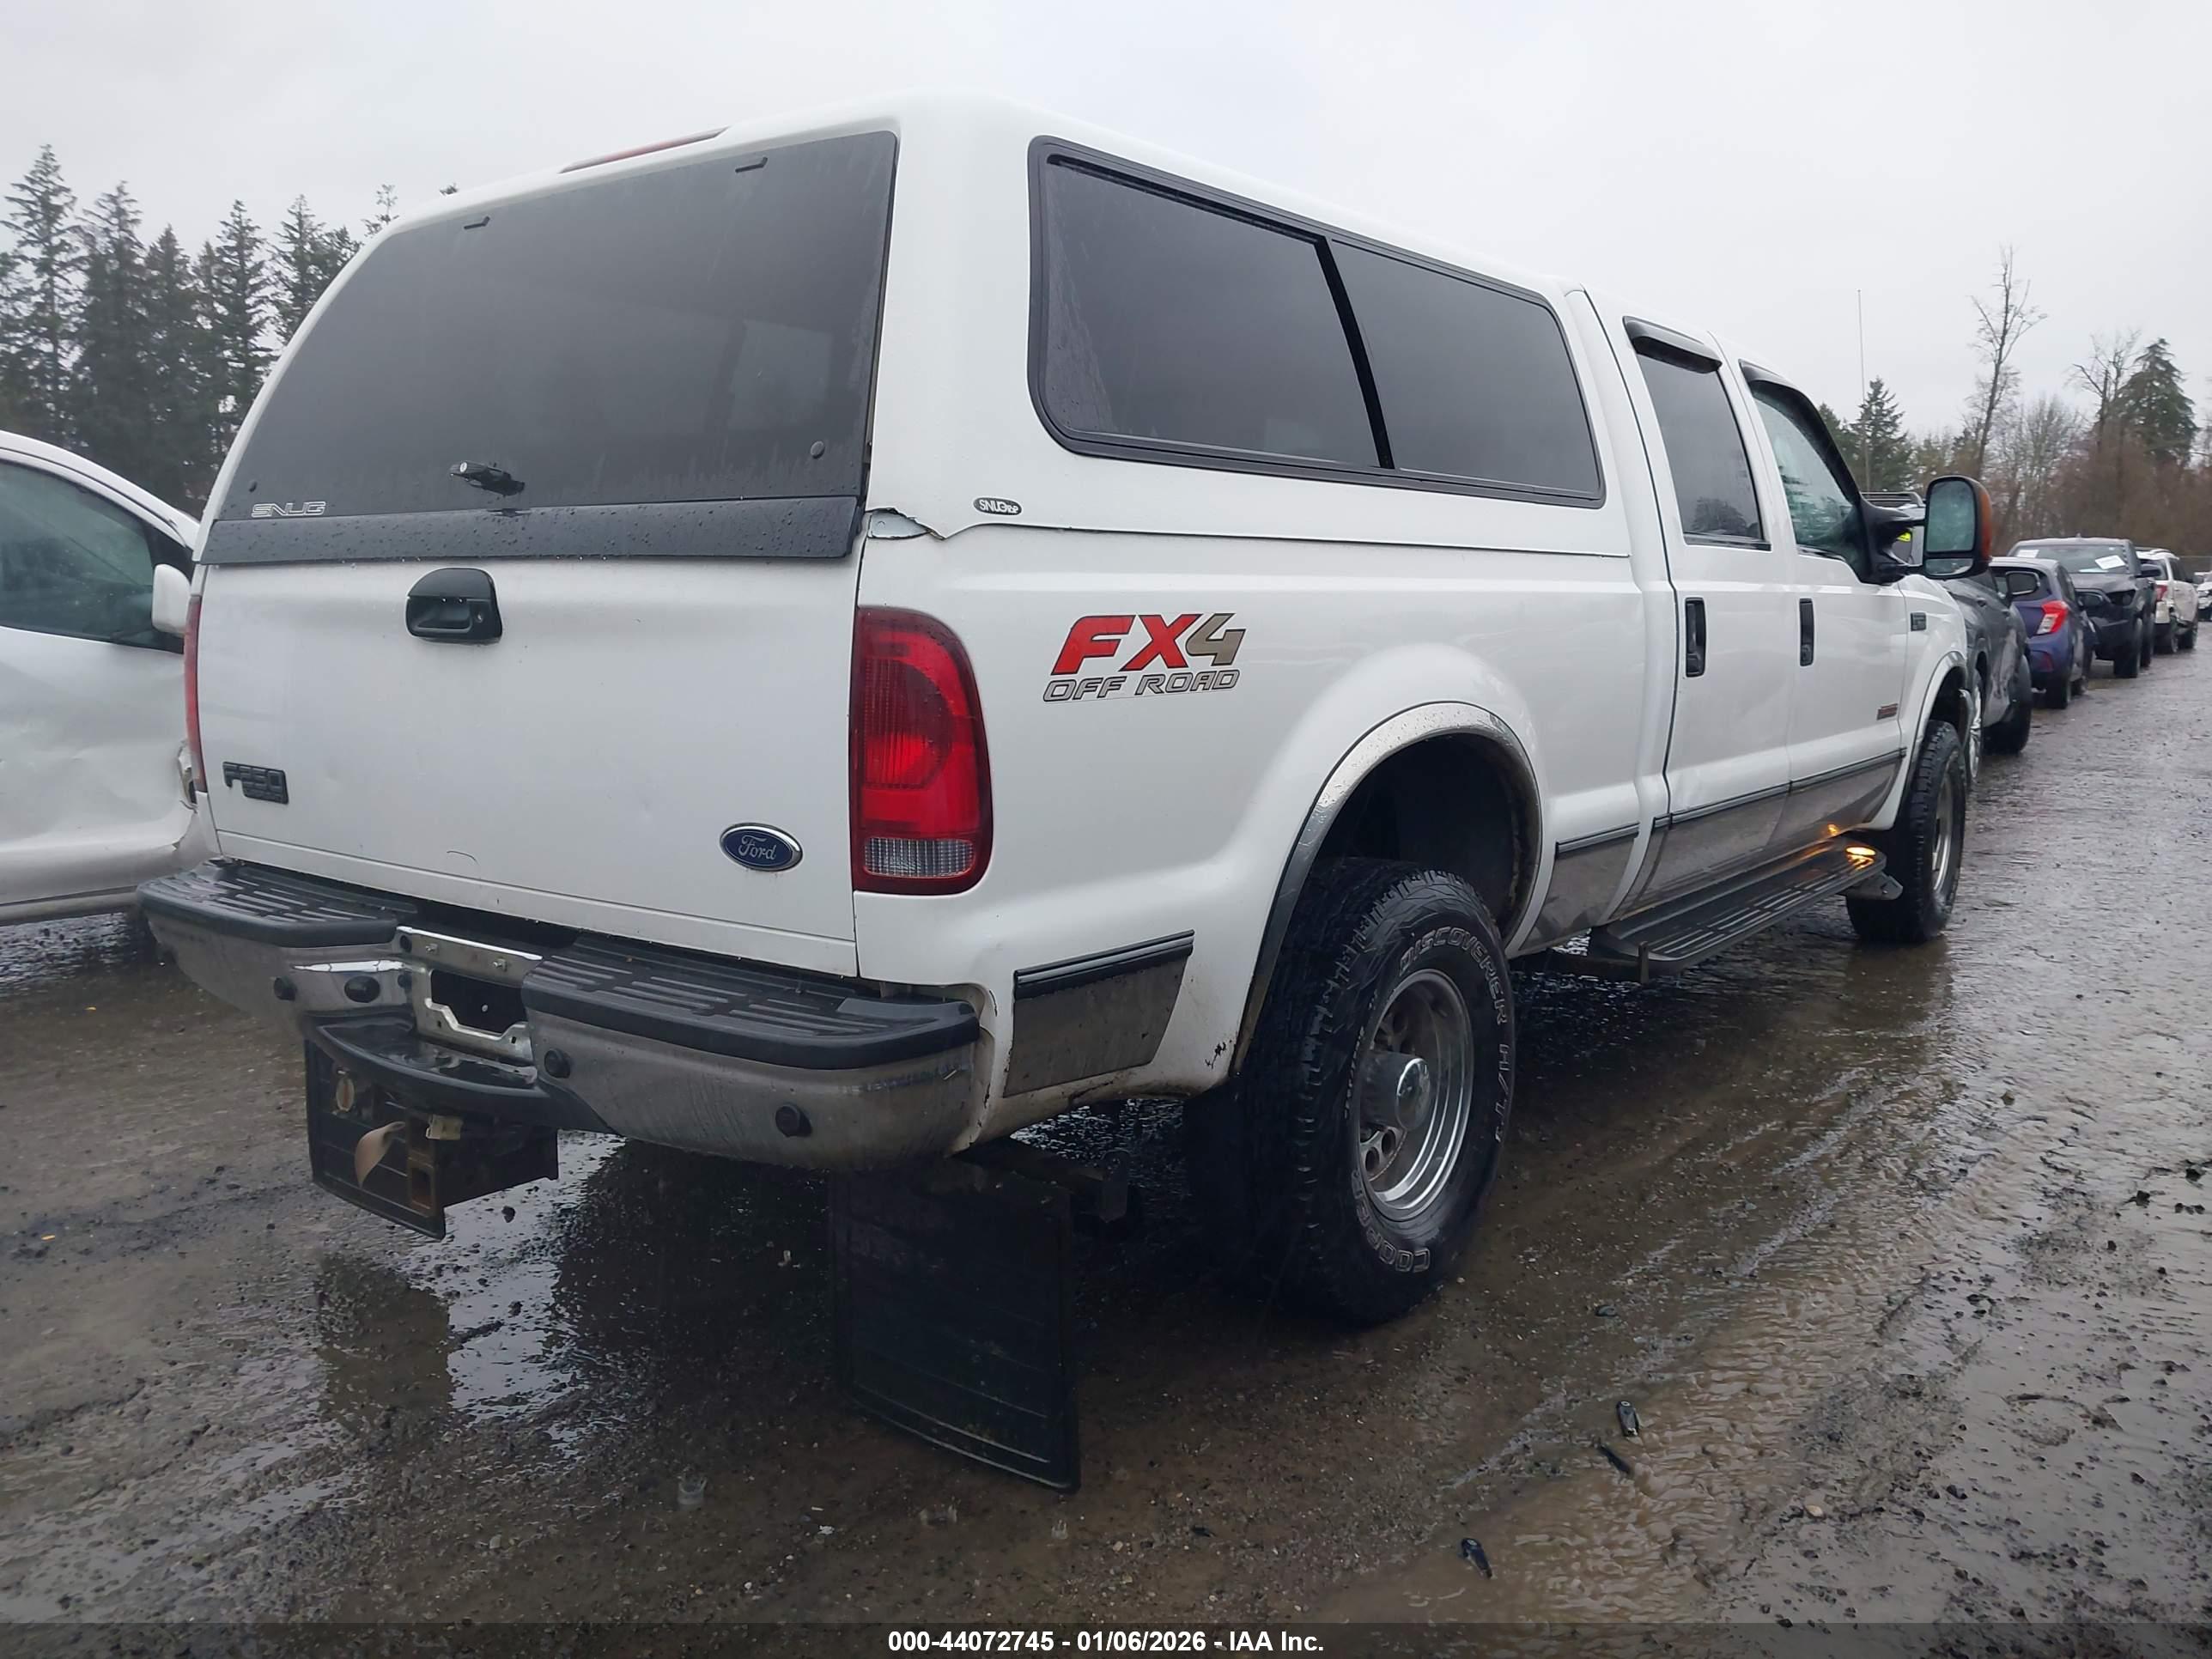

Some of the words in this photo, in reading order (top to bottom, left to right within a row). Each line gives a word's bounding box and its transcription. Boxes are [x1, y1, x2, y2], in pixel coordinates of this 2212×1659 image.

[251, 501, 326, 518] SNUG
[1050, 612, 1246, 676] FX4
[1042, 676, 1127, 702] OFF
[1133, 669, 1240, 696] ROAD
[738, 834, 777, 860] Ford
[1399, 926, 1508, 1026] DISCOVERER
[1351, 1169, 1431, 1273] COOPER
